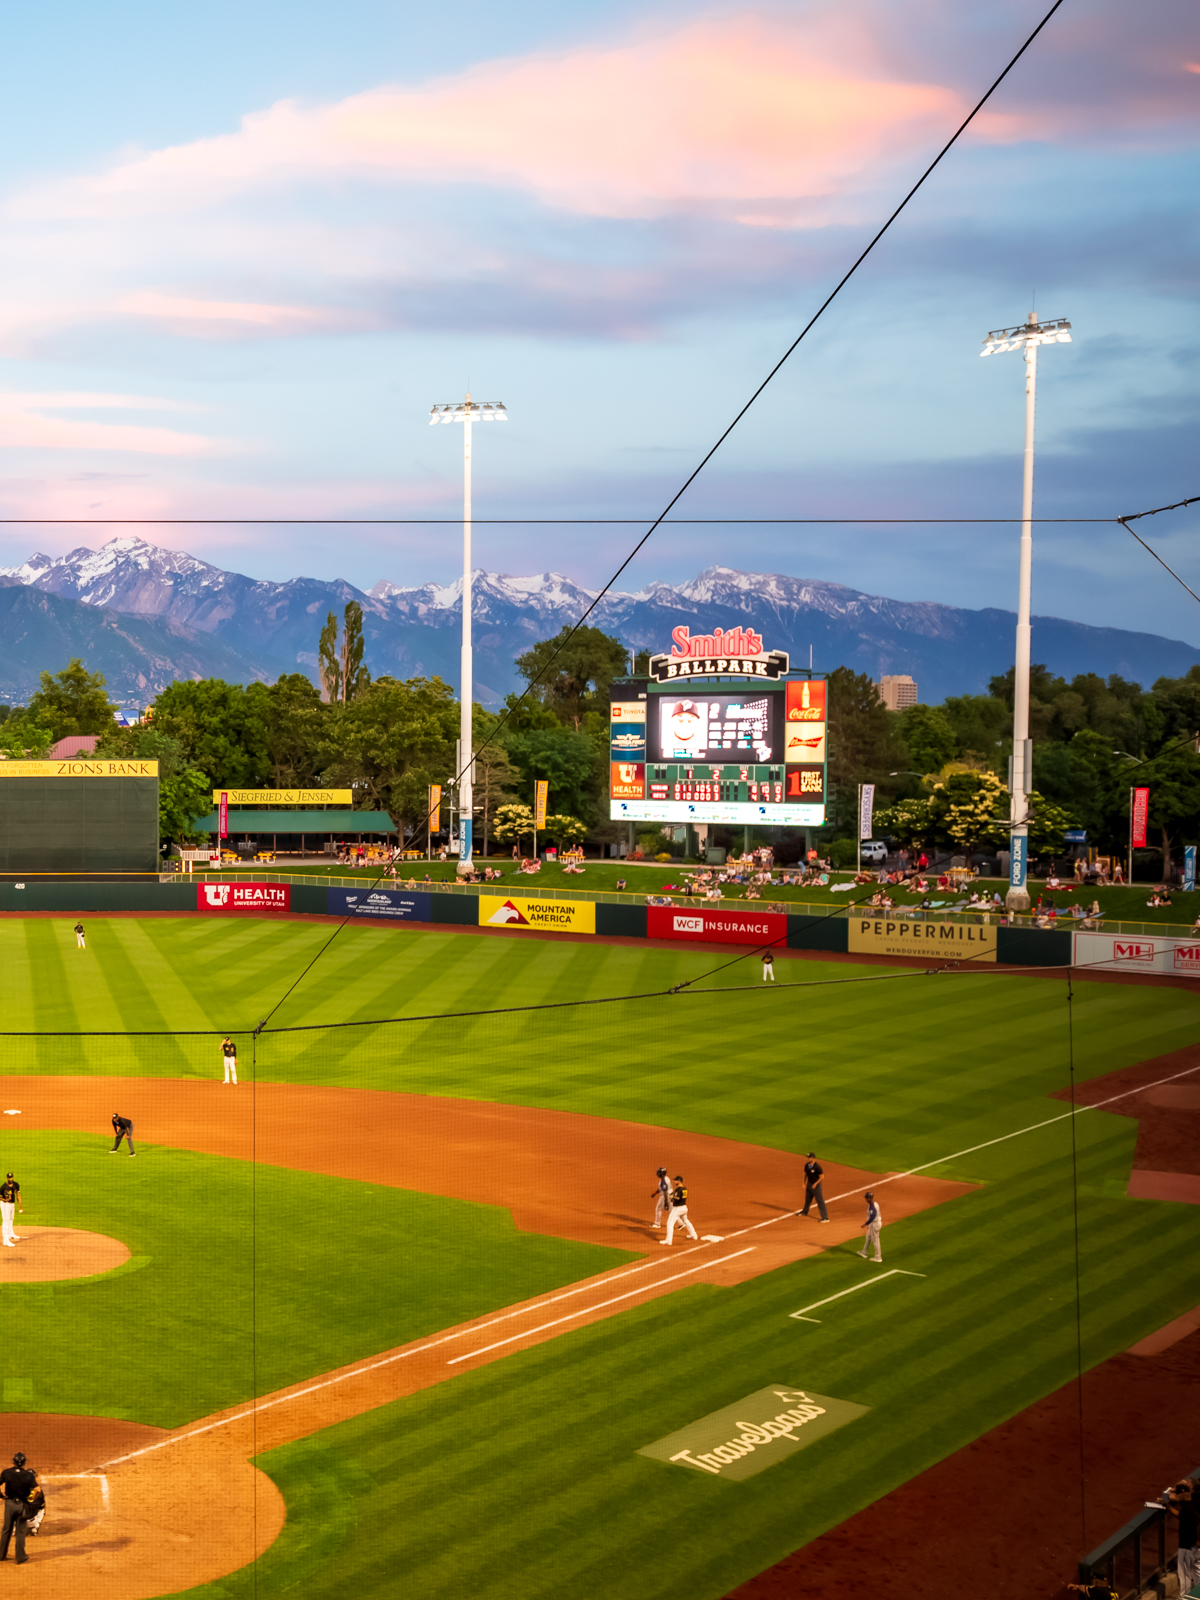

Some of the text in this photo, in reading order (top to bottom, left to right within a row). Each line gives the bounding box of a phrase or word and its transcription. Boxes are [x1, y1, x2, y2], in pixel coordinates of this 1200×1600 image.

[671, 625, 763, 658] Smith's
[667, 660, 768, 678] BALLPARK
[57, 764, 150, 774] ZIONS BANK
[712, 769, 720, 780] 2
[740, 769, 748, 781] 2
[788, 771, 803, 796] 1
[231, 791, 334, 802] SIEGFRIED & JENSEN
[862, 787, 872, 833] SKYSCRAPERS
[1134, 790, 1147, 841] OCCIDENTALS
[1013, 862, 1021, 884] FORD
[234, 888, 285, 900] HEALTH
[528, 905, 575, 914] MOUNTAIN
[530, 914, 572, 924] AMERICA
[676, 919, 768, 934] WCF INSURANCE
[861, 921, 988, 942] PEPPERMILL
[886, 947, 962, 957] WENDOVERFUN.COM
[1116, 944, 1151, 958] MH
[669, 1404, 827, 1474] Travelpass
